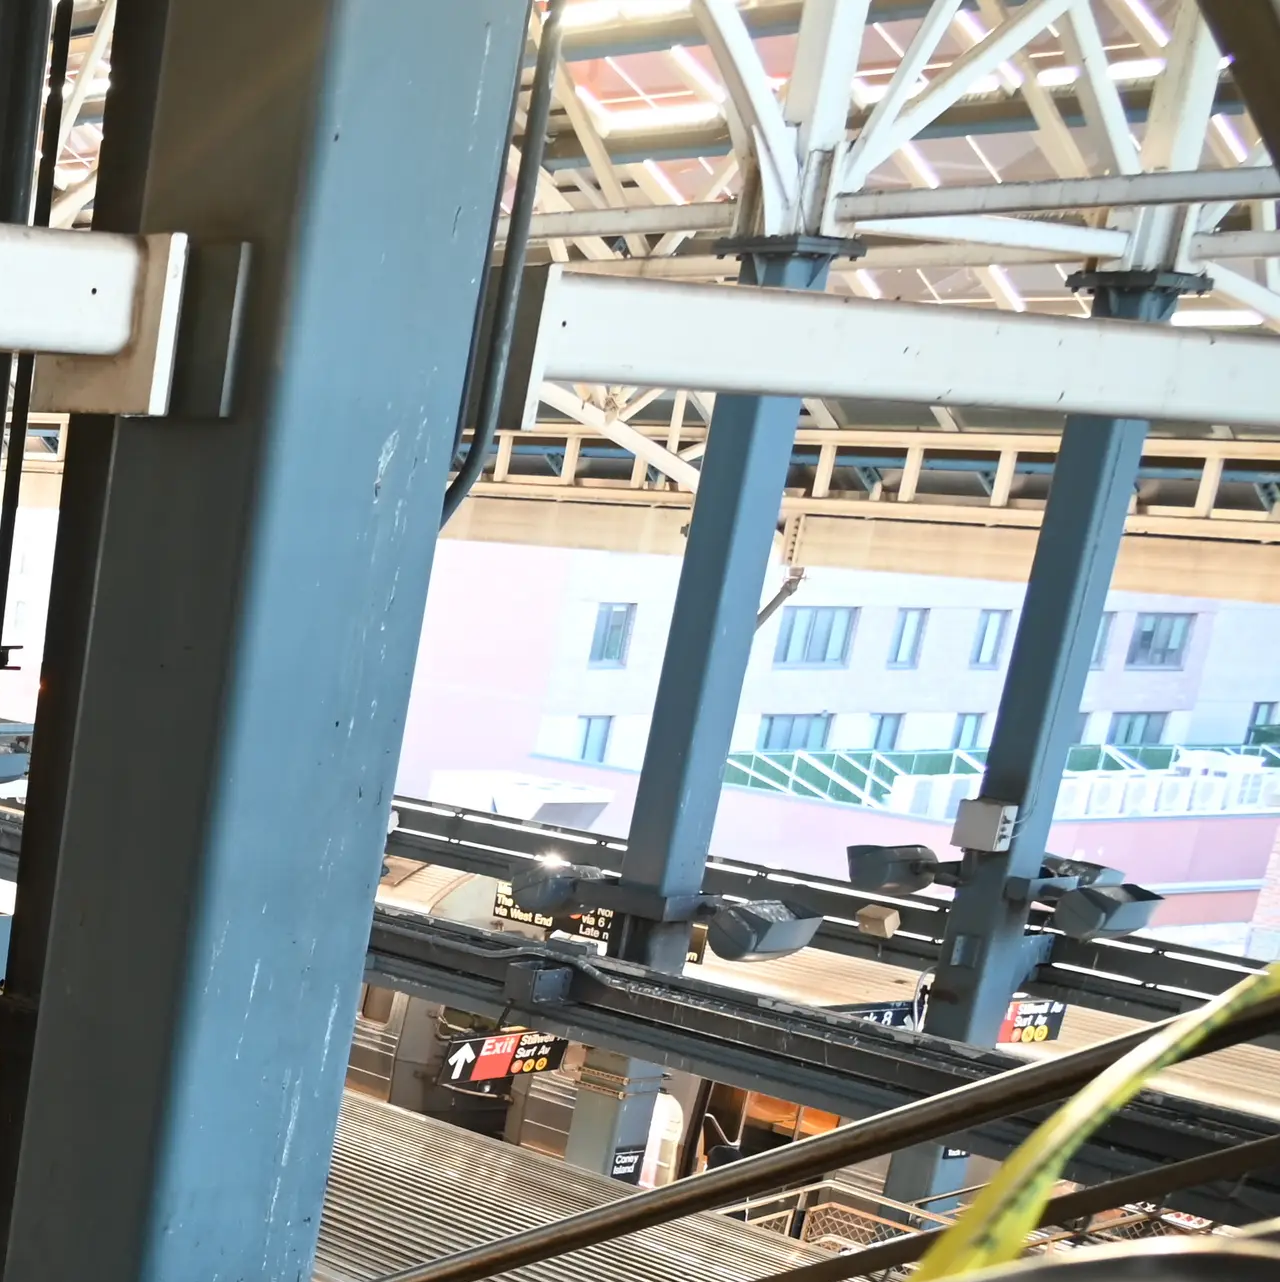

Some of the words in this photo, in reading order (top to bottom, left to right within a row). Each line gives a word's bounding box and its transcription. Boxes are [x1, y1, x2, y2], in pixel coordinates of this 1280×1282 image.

[497, 894, 514, 907] The
[495, 906, 508, 917] via
[510, 907, 533, 922] West
[534, 913, 553, 927] End
[582, 914, 595, 926] via
[598, 917, 606, 928] 6
[579, 923, 600, 938] Late
[881, 1010, 893, 1026] 8
[480, 1037, 515, 1056] Exit
[515, 1045, 538, 1058] Surf
[537, 1045, 551, 1056] Av
[615, 1155, 639, 1166] Coney
[613, 1164, 635, 1175] Island
